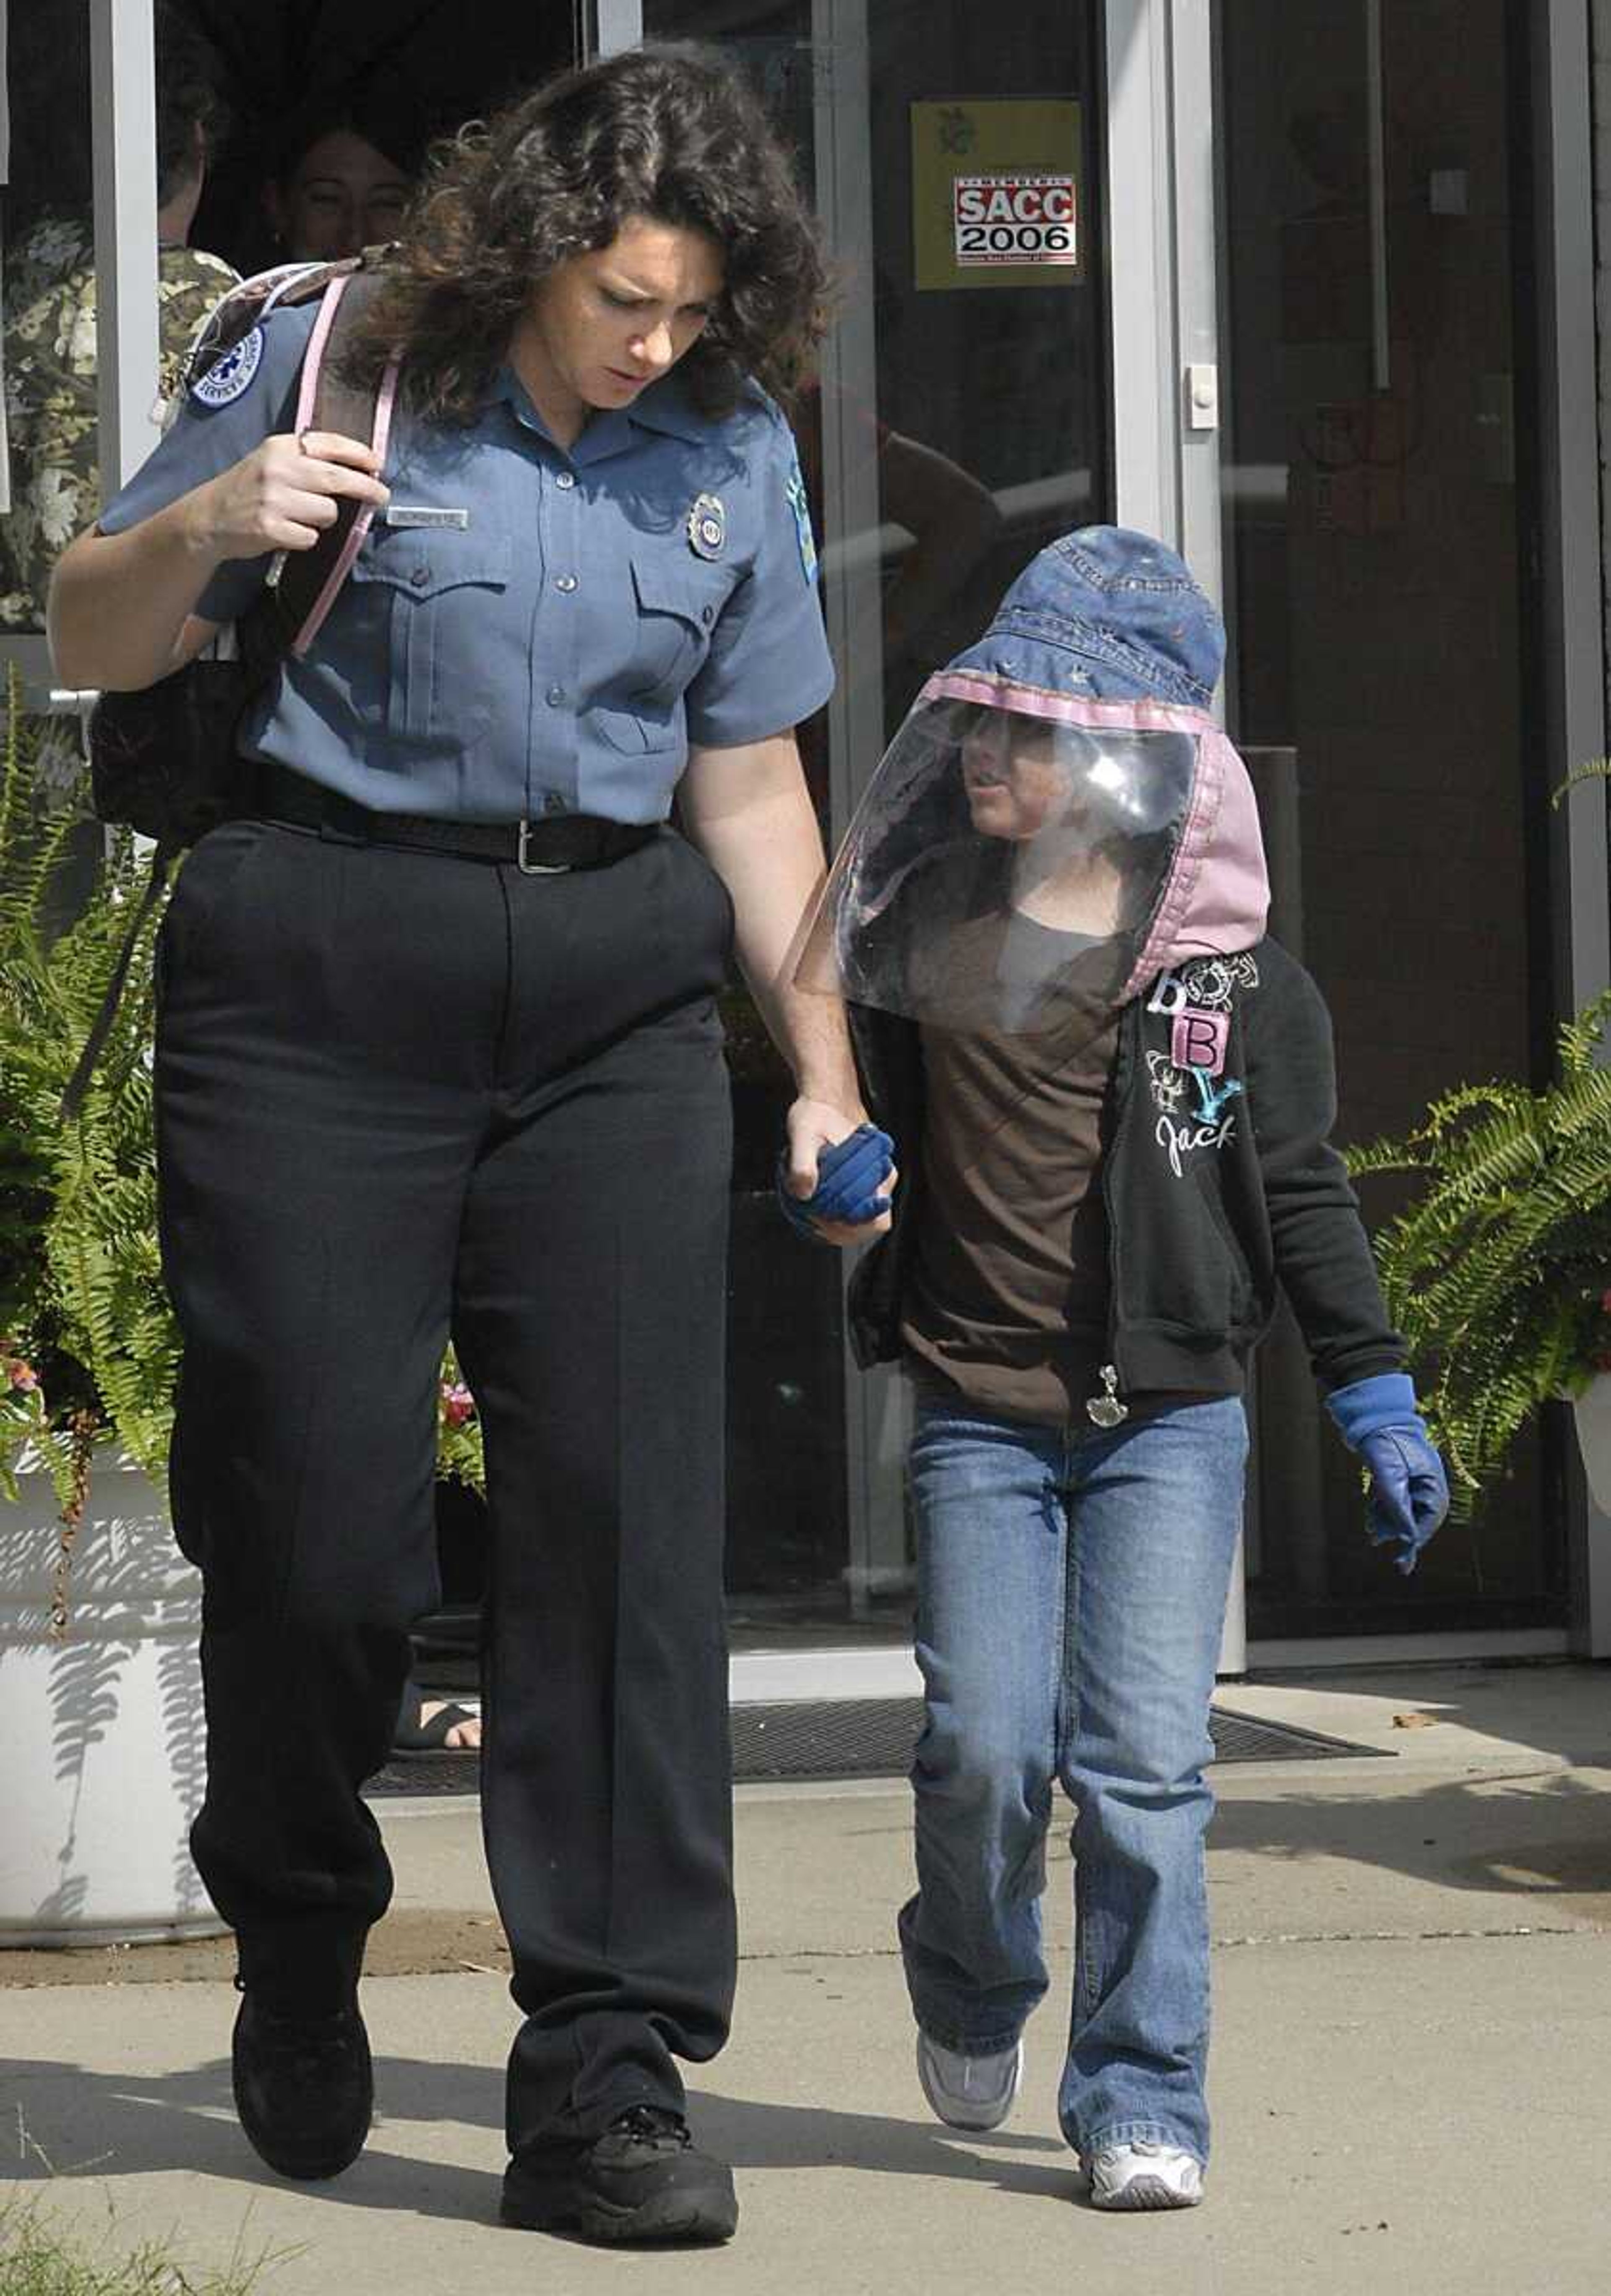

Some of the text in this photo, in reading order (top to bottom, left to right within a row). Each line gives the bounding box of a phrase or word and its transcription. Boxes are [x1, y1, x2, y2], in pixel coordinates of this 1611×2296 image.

[959, 189, 1071, 223] SACC
[962, 226, 1070, 251] 2006
[1155, 1115, 1235, 1178] Jack
